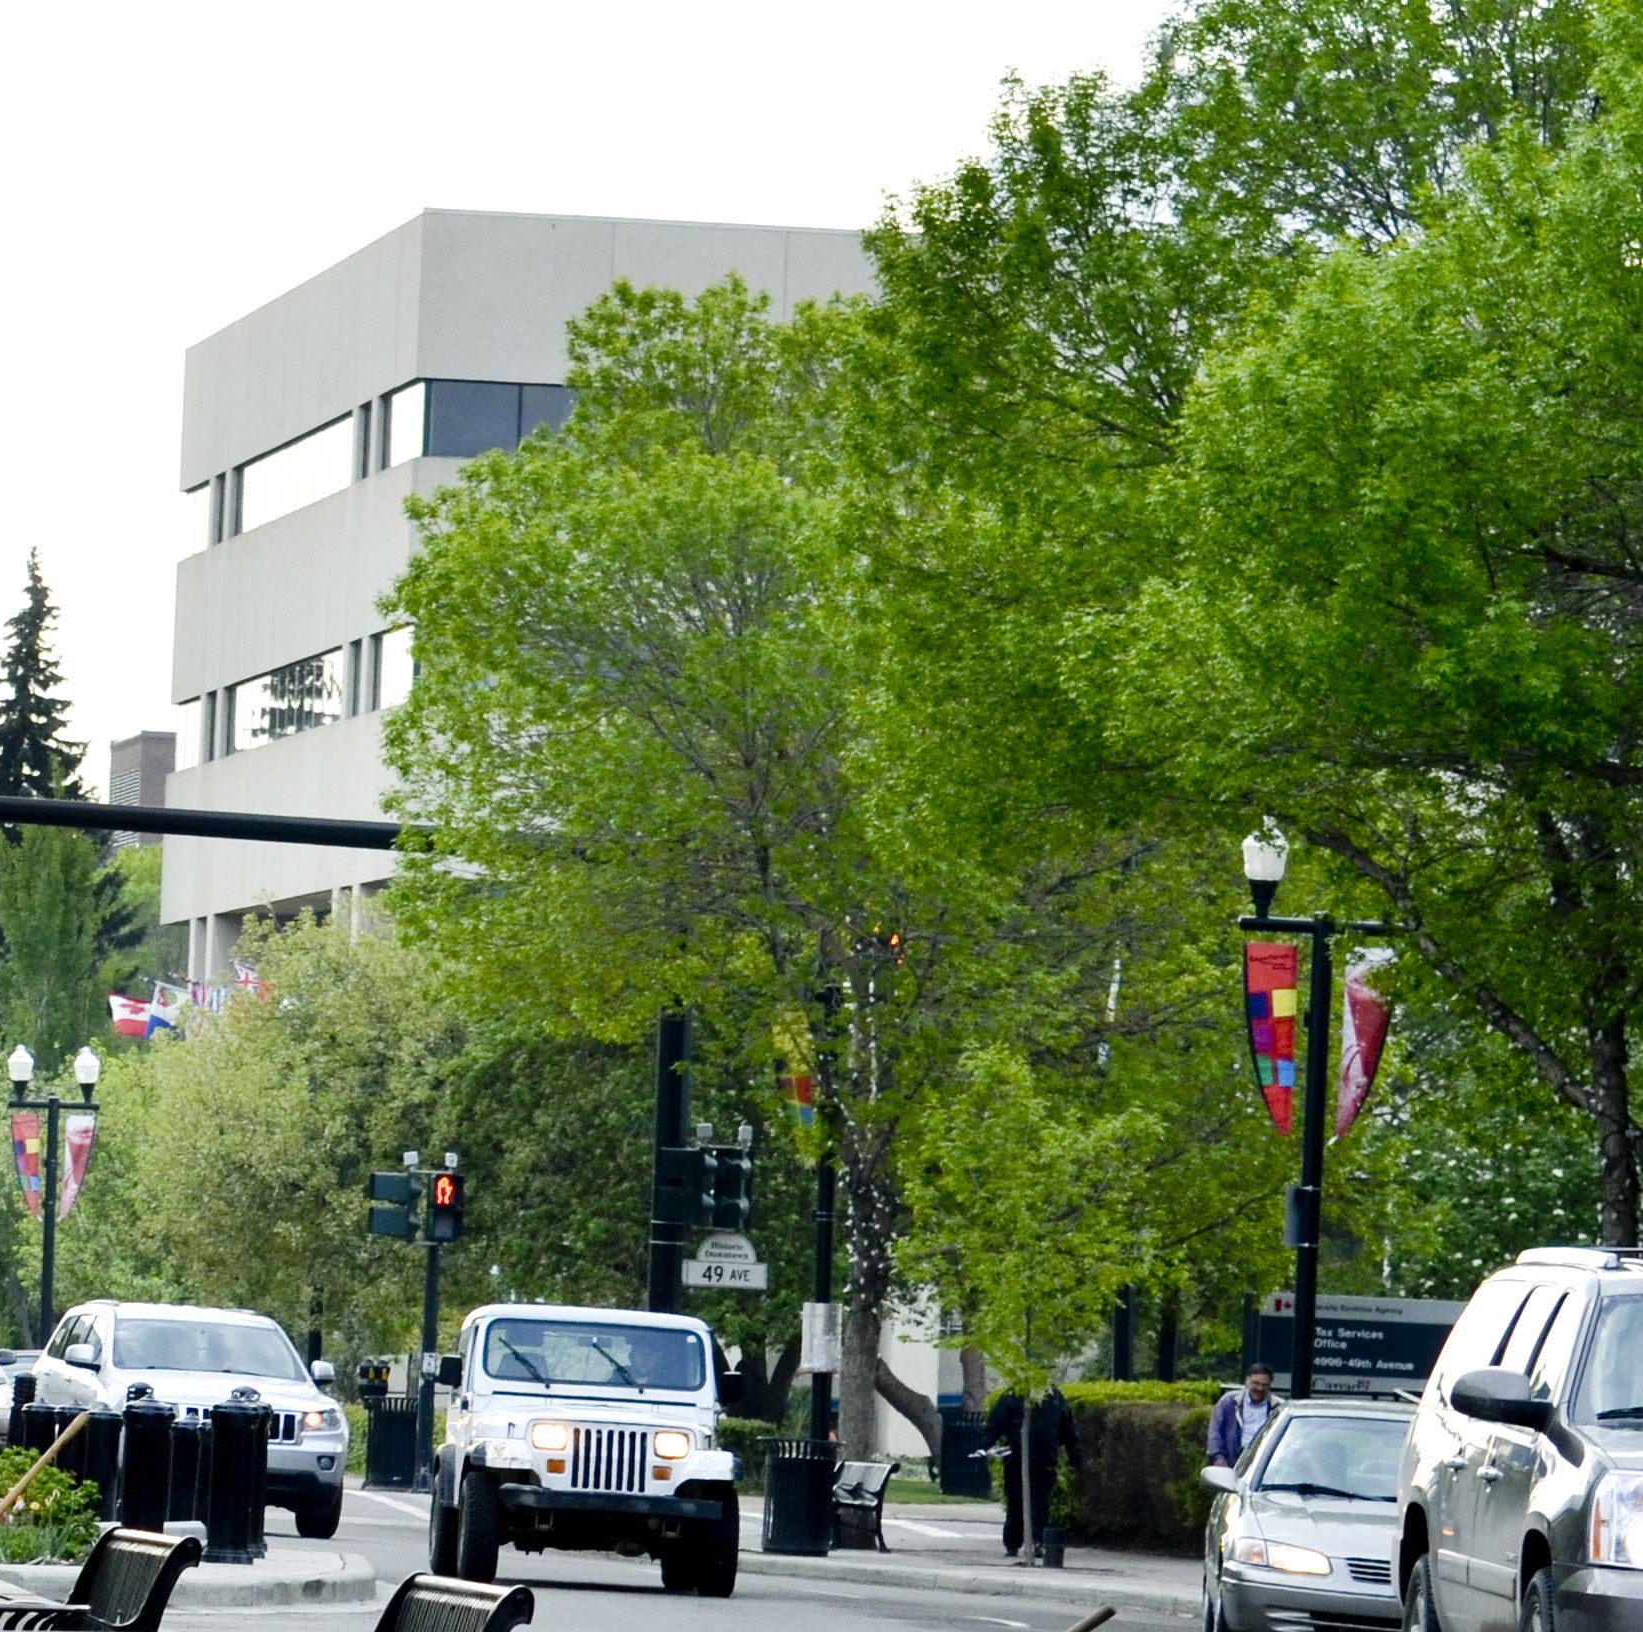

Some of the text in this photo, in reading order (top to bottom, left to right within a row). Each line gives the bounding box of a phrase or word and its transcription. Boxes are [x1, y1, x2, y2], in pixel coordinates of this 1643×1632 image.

[702, 1265, 751, 1282] 49 AVE
[1316, 1327, 1384, 1340] Tax Services
[1314, 1338, 1347, 1350] Office
[1376, 1359, 1414, 1371] Avenue
